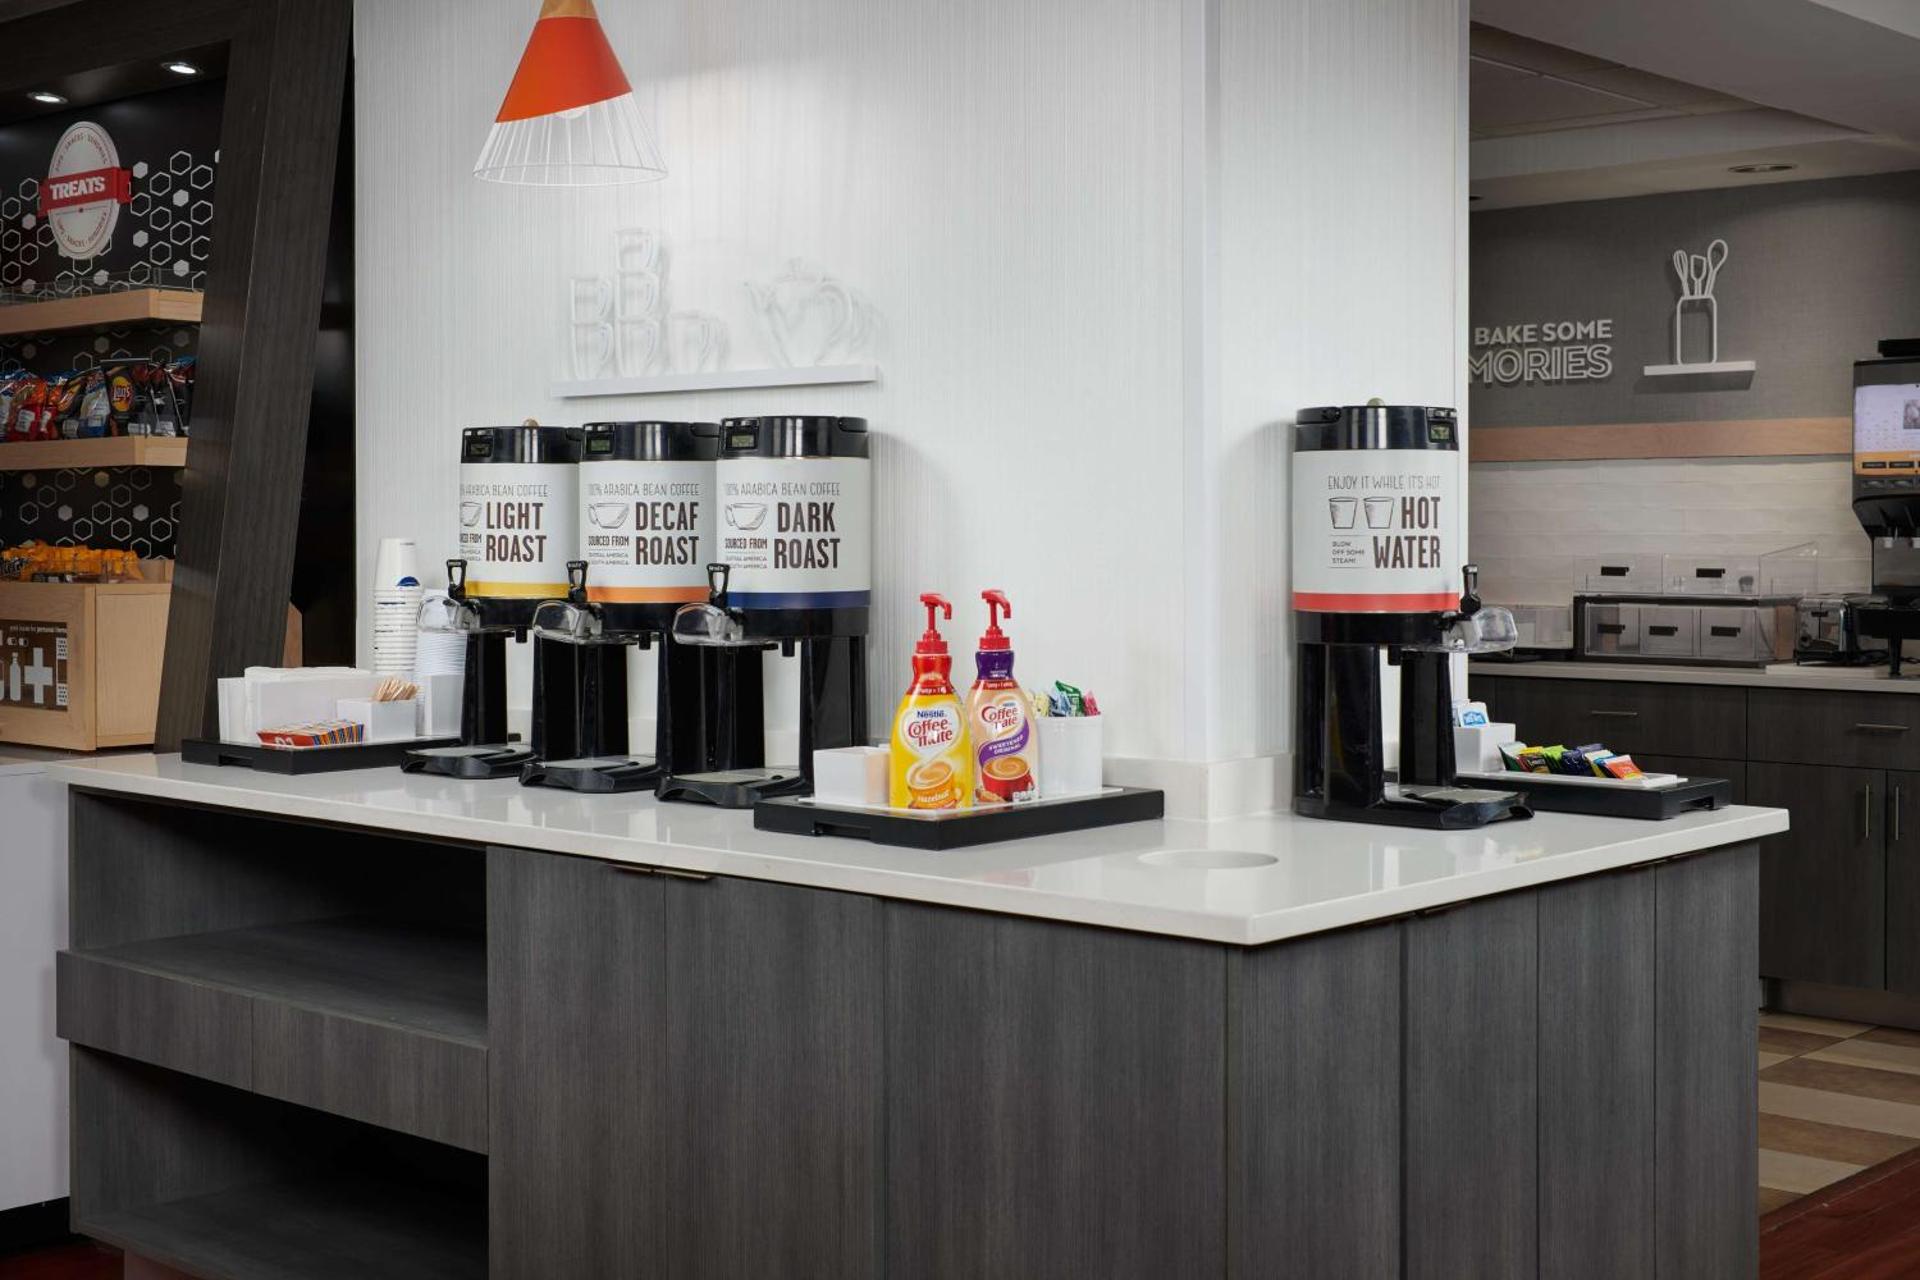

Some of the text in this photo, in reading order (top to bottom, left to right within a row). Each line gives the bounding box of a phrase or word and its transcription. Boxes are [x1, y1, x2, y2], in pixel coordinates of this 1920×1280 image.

[49, 177, 106, 200] TREATS
[1474, 319, 1613, 345] BAKE SOME
[1468, 344, 1613, 383] MORIES
[493, 484, 514, 497] BEAN
[517, 484, 549, 498] COFFEE
[604, 484, 640, 497] ARABICA
[643, 484, 667, 497] BEAN
[670, 484, 700, 497] COFFEE
[741, 483, 778, 496] ARABICA
[781, 483, 807, 496] BEAN
[810, 482, 841, 496] COFFEE
[1328, 475, 1357, 490] ENJOY
[1361, 475, 1370, 489] IT
[1373, 475, 1404, 490] WHILE
[1426, 475, 1441, 489] HOT
[486, 502, 544, 530] LIGHT
[635, 502, 699, 531] DECAF
[777, 502, 836, 532] DARK
[1401, 496, 1441, 529] HOT
[486, 535, 547, 562] ROAST
[612, 536, 629, 546] FROM
[635, 536, 699, 565] ROAST
[749, 538, 767, 549] FROM
[774, 538, 840, 569] ROAST
[1373, 535, 1441, 568] WATER
[981, 705, 1018, 722] Coffee
[908, 719, 948, 738] Coffee
